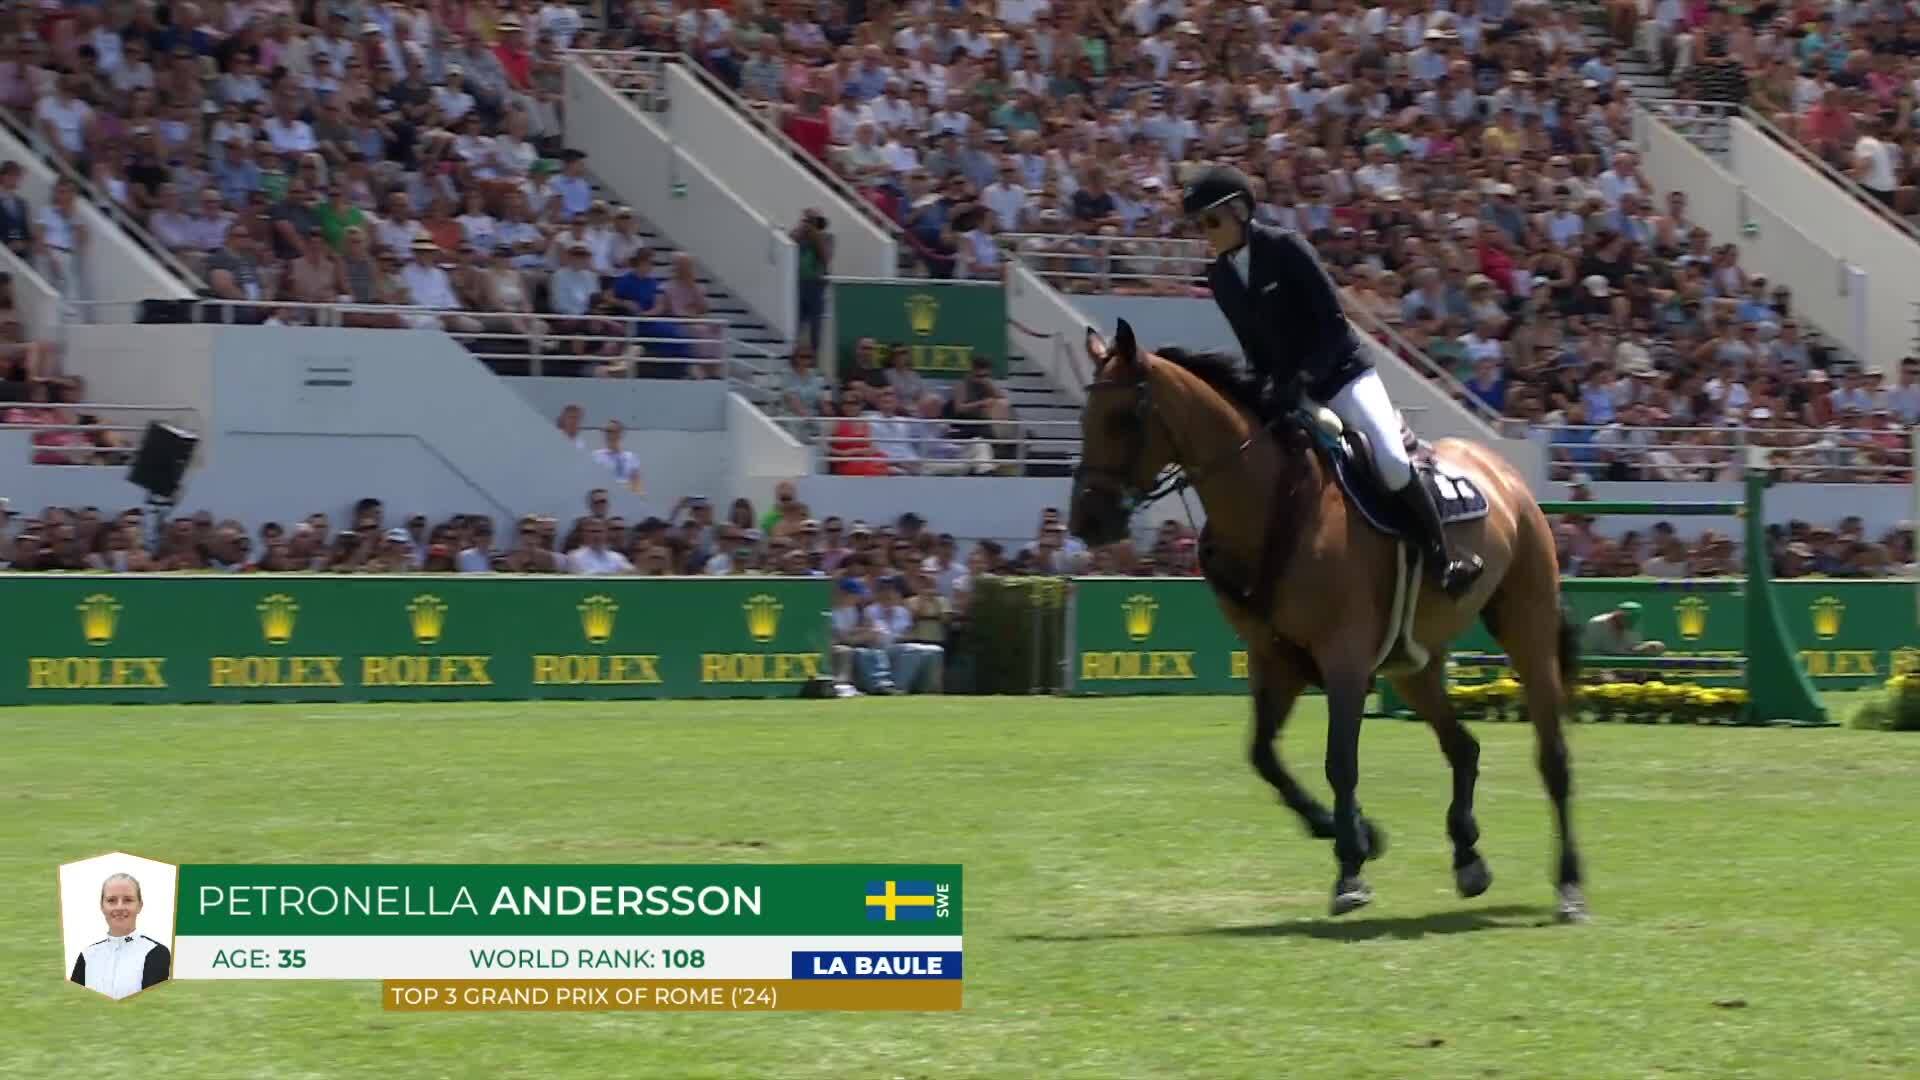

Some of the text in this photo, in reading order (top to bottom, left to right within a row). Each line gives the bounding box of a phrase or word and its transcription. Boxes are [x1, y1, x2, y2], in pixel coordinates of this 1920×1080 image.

[27, 656, 168, 689] ROLEX
[209, 656, 344, 687] ROLEX
[361, 655, 494, 686] ROLEX
[532, 654, 664, 684] ROLEX
[700, 652, 823, 683] ROLEX
[1080, 651, 1197, 680] ROLEX
